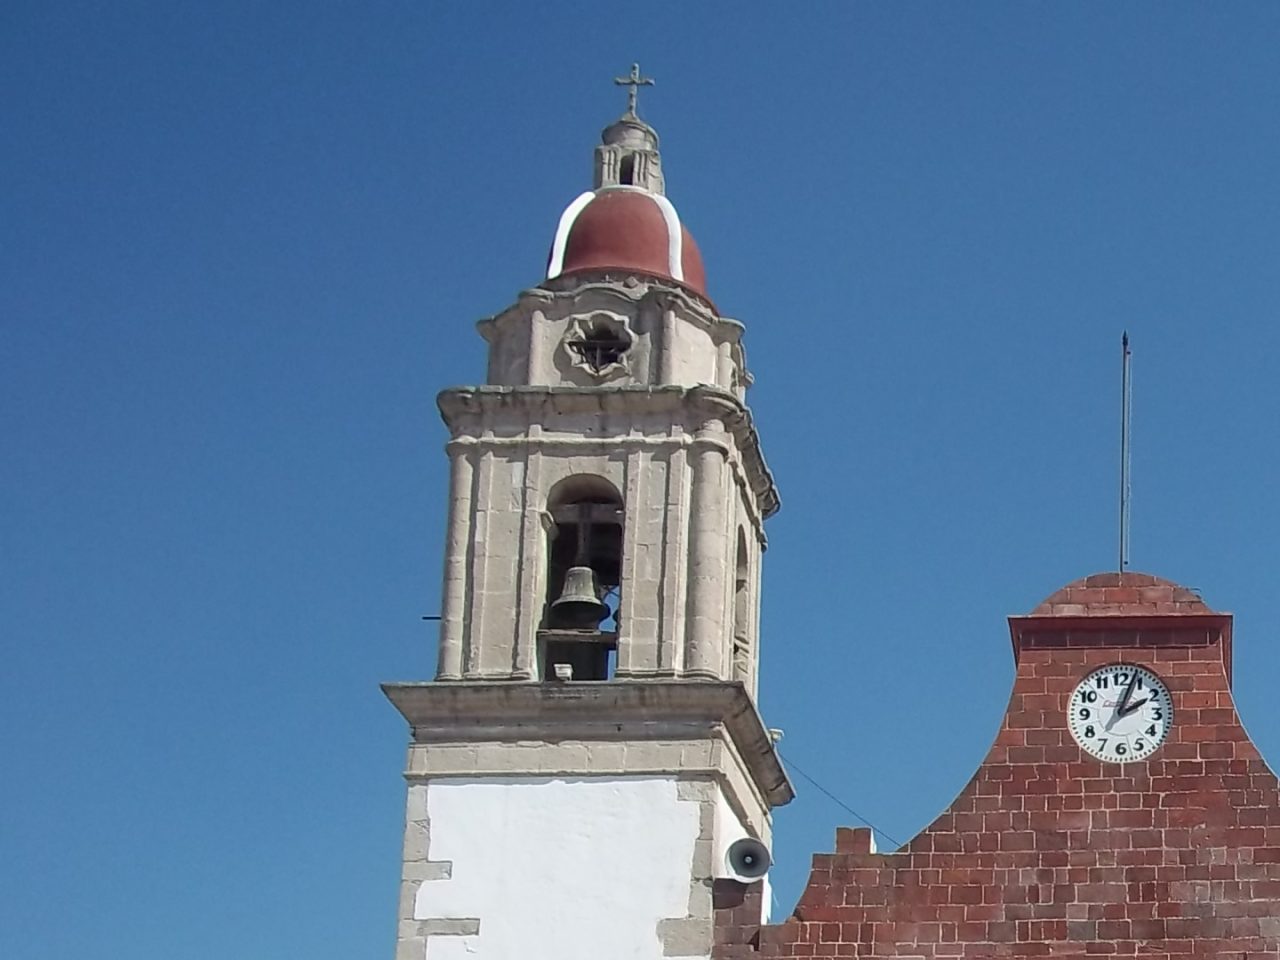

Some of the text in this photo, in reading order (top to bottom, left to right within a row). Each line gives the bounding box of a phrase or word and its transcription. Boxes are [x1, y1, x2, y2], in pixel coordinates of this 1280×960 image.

[1096, 677, 1108, 689] 11
[1113, 673, 1129, 686] 12
[1137, 678, 1142, 690] 1
[1081, 690, 1097, 703] 10
[1149, 689, 1159, 702] 2
[1079, 709, 1090, 720] 9
[1152, 707, 1162, 720] 3
[1084, 726, 1095, 738] 8
[1145, 724, 1157, 736] 4
[1098, 738, 1108, 752] 7
[1115, 743, 1126, 755] 6
[1134, 738, 1144, 751] 5
